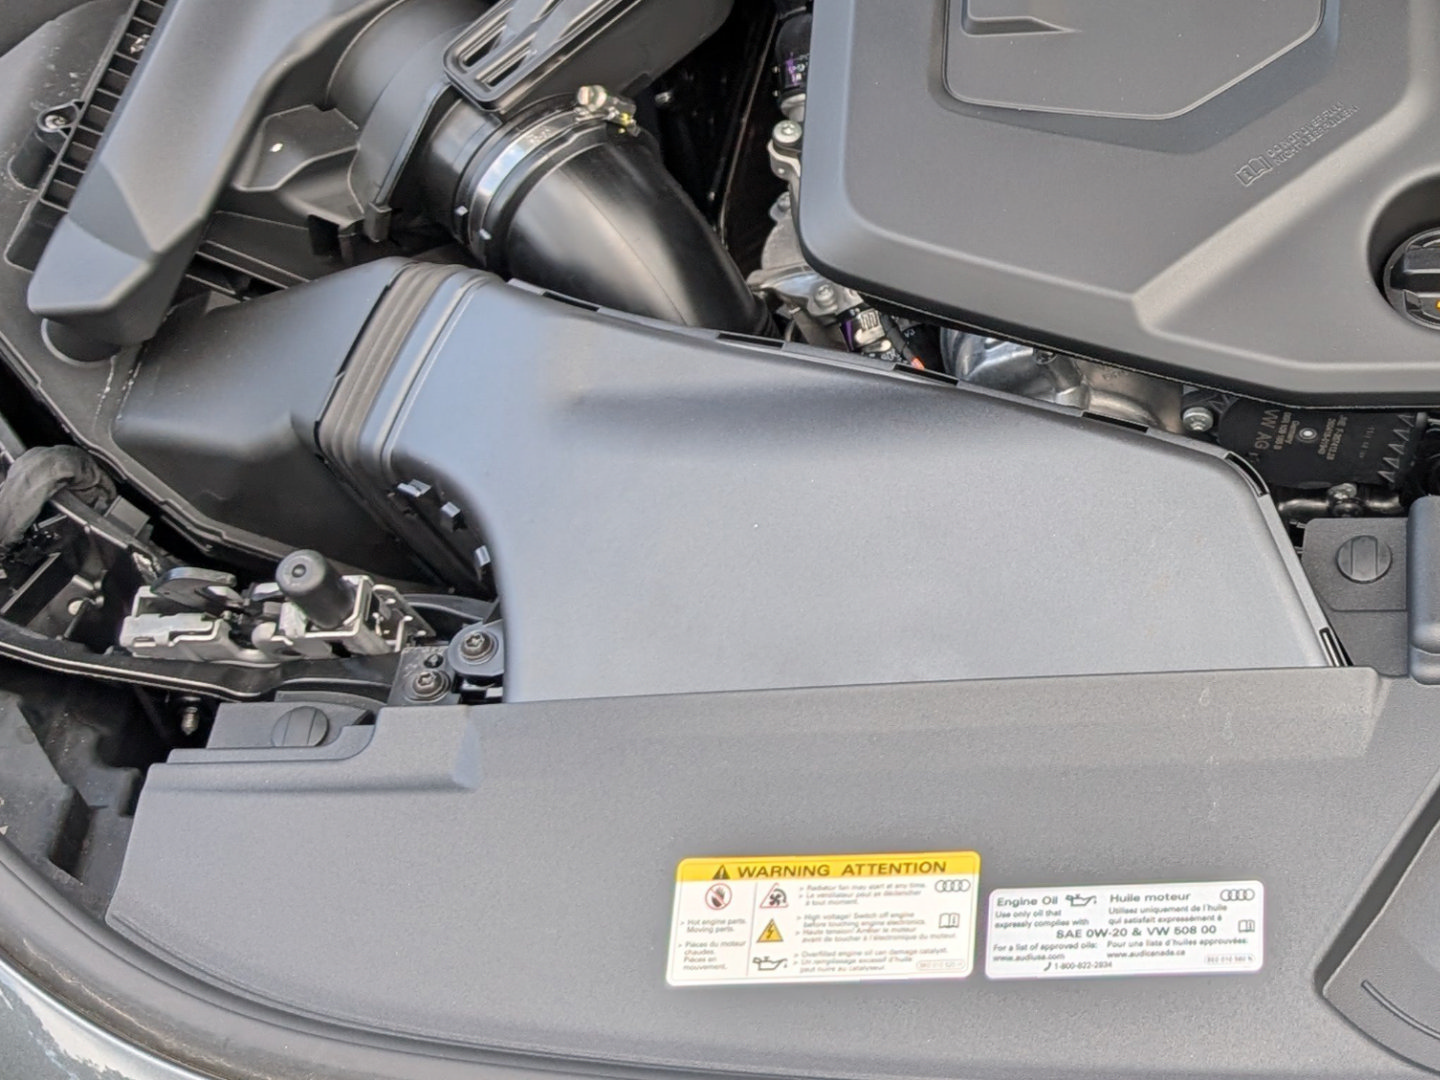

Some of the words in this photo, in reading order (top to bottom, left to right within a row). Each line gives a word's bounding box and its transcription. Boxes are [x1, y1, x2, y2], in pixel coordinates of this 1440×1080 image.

[1261, 409, 1280, 428] VW
[1255, 431, 1272, 449] AG
[738, 864, 831, 878] WARNING
[841, 862, 946, 876] ATTENTION
[997, 897, 1038, 908] Engine
[1042, 896, 1058, 905] Oil
[1110, 894, 1140, 903] Huile
[1144, 893, 1191, 901] moteur
[1140, 905, 1189, 914] uniquement
[1203, 904, 1227, 912] l'huile
[1013, 911, 1031, 919] only
[995, 921, 1032, 929] expressly
[1034, 920, 1070, 928] complies
[1056, 929, 1082, 939] SAE
[1086, 928, 1127, 938] 0W-20
[1132, 928, 1141, 936] &
[1147, 926, 1170, 936] VW
[1174, 926, 1197, 935] 508
[1201, 925, 1217, 934] 00
[1040, 942, 1078, 950] approved
[993, 953, 1065, 961] www.audiusa.com
[1107, 949, 1185, 958] www.audicanada.ca
